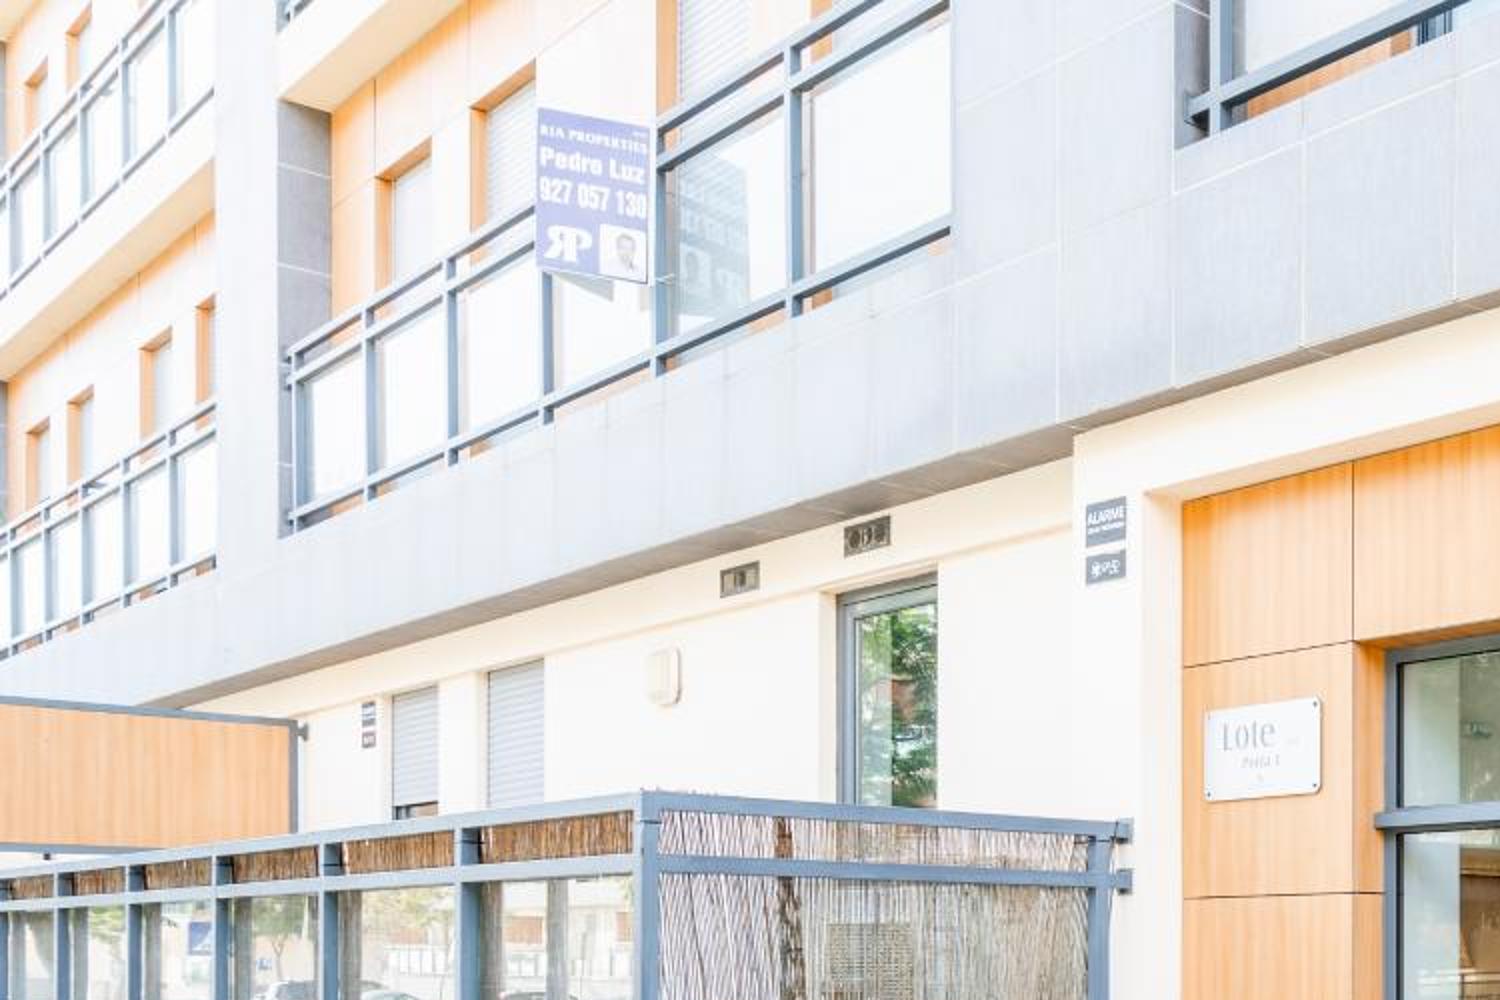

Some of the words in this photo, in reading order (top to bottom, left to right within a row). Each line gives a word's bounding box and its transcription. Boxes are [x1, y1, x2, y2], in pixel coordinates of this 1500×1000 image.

[540, 147, 602, 175] Pedro
[609, 159, 645, 185] Luz
[540, 176, 572, 204] 927
[577, 183, 610, 212] 057
[616, 190, 647, 218] 130
[1221, 719, 1276, 752] Lote
